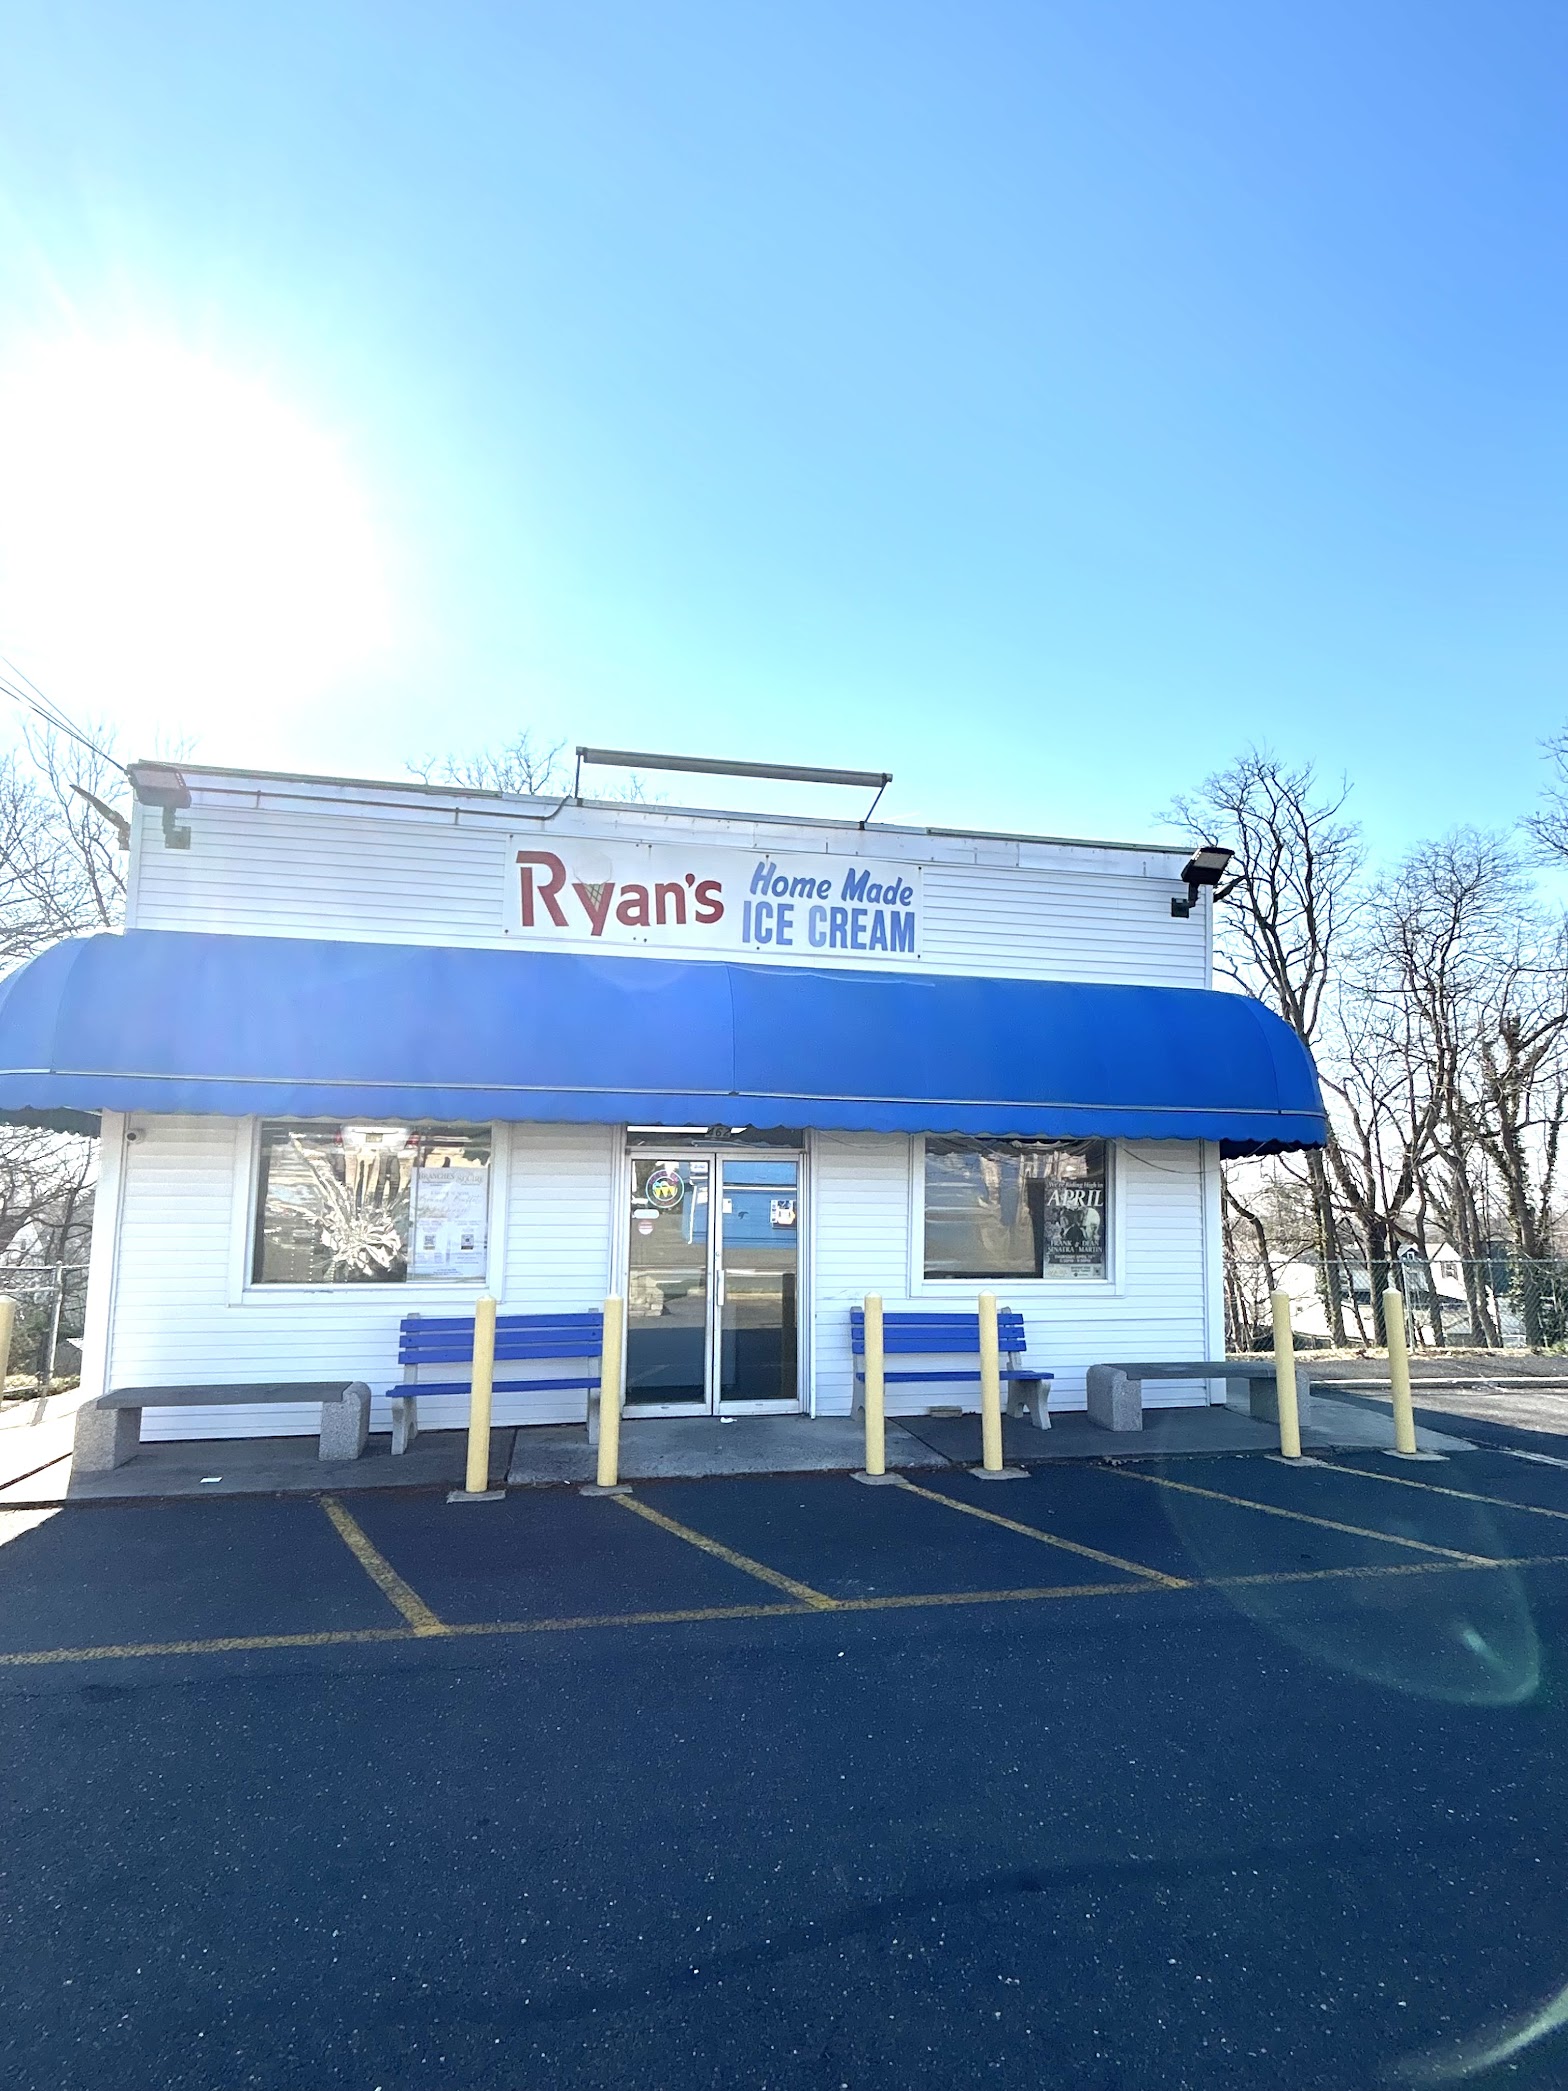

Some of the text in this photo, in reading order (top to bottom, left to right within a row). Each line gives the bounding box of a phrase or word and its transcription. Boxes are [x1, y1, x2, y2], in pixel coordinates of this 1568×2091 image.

[516, 850, 725, 936] Ryan's
[750, 861, 914, 907] Home Made
[742, 901, 915, 953] ICE CREAM
[1046, 1189, 1104, 1207] APRIL
